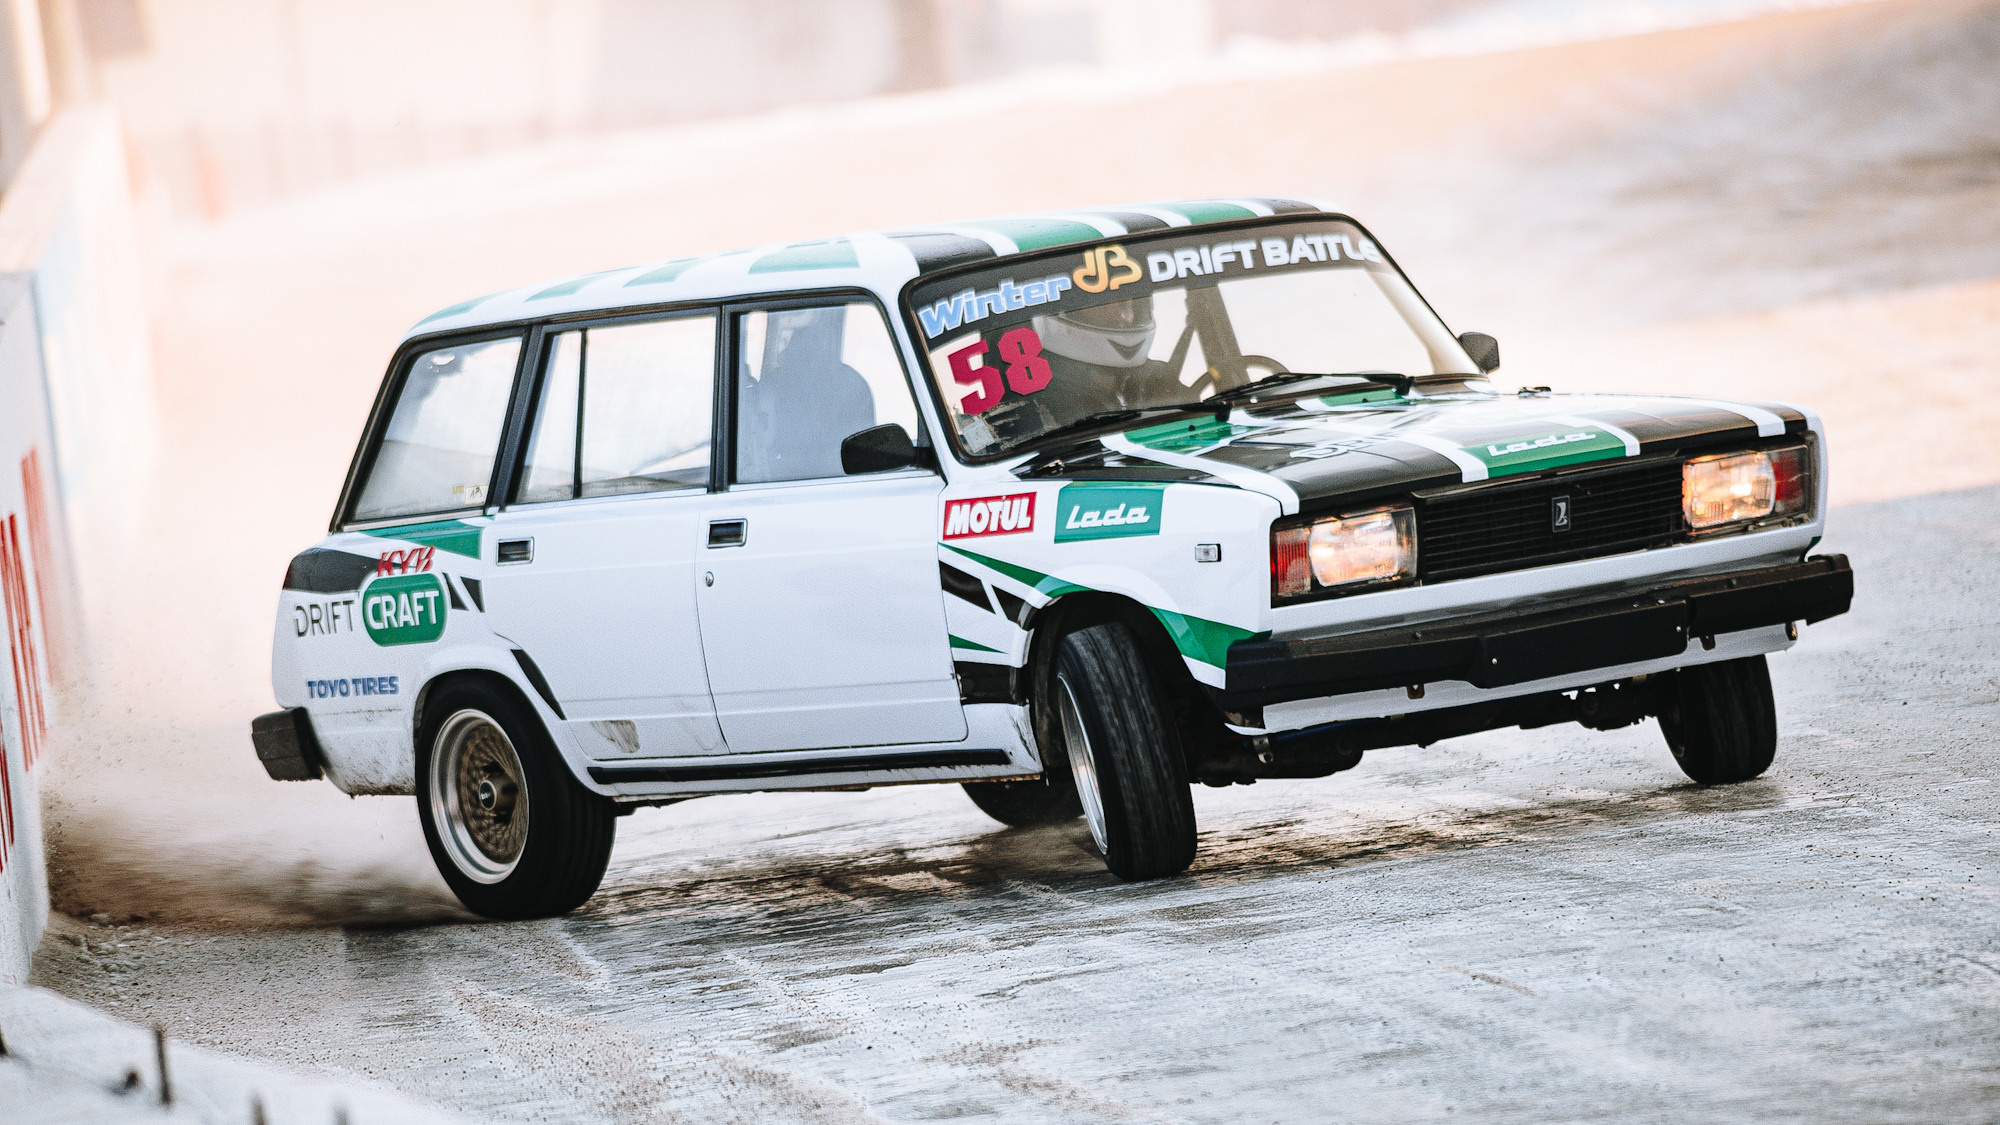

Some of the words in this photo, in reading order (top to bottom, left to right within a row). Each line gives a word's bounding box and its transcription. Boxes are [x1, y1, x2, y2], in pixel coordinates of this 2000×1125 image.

[918, 274, 1072, 339] Winter
[1148, 241, 1257, 282] DRIFT
[1261, 234, 1382, 264] BATTLE
[948, 328, 1053, 416] 58
[1487, 432, 1596, 456] Lada
[946, 498, 1031, 535] MOTUL
[1066, 503, 1150, 529] Lada
[378, 546, 436, 577] KYB
[295, 600, 355, 637] DRIFT
[367, 591, 440, 630] CRAFT
[308, 679, 349, 698] TOYO
[352, 676, 399, 696] TIRES
